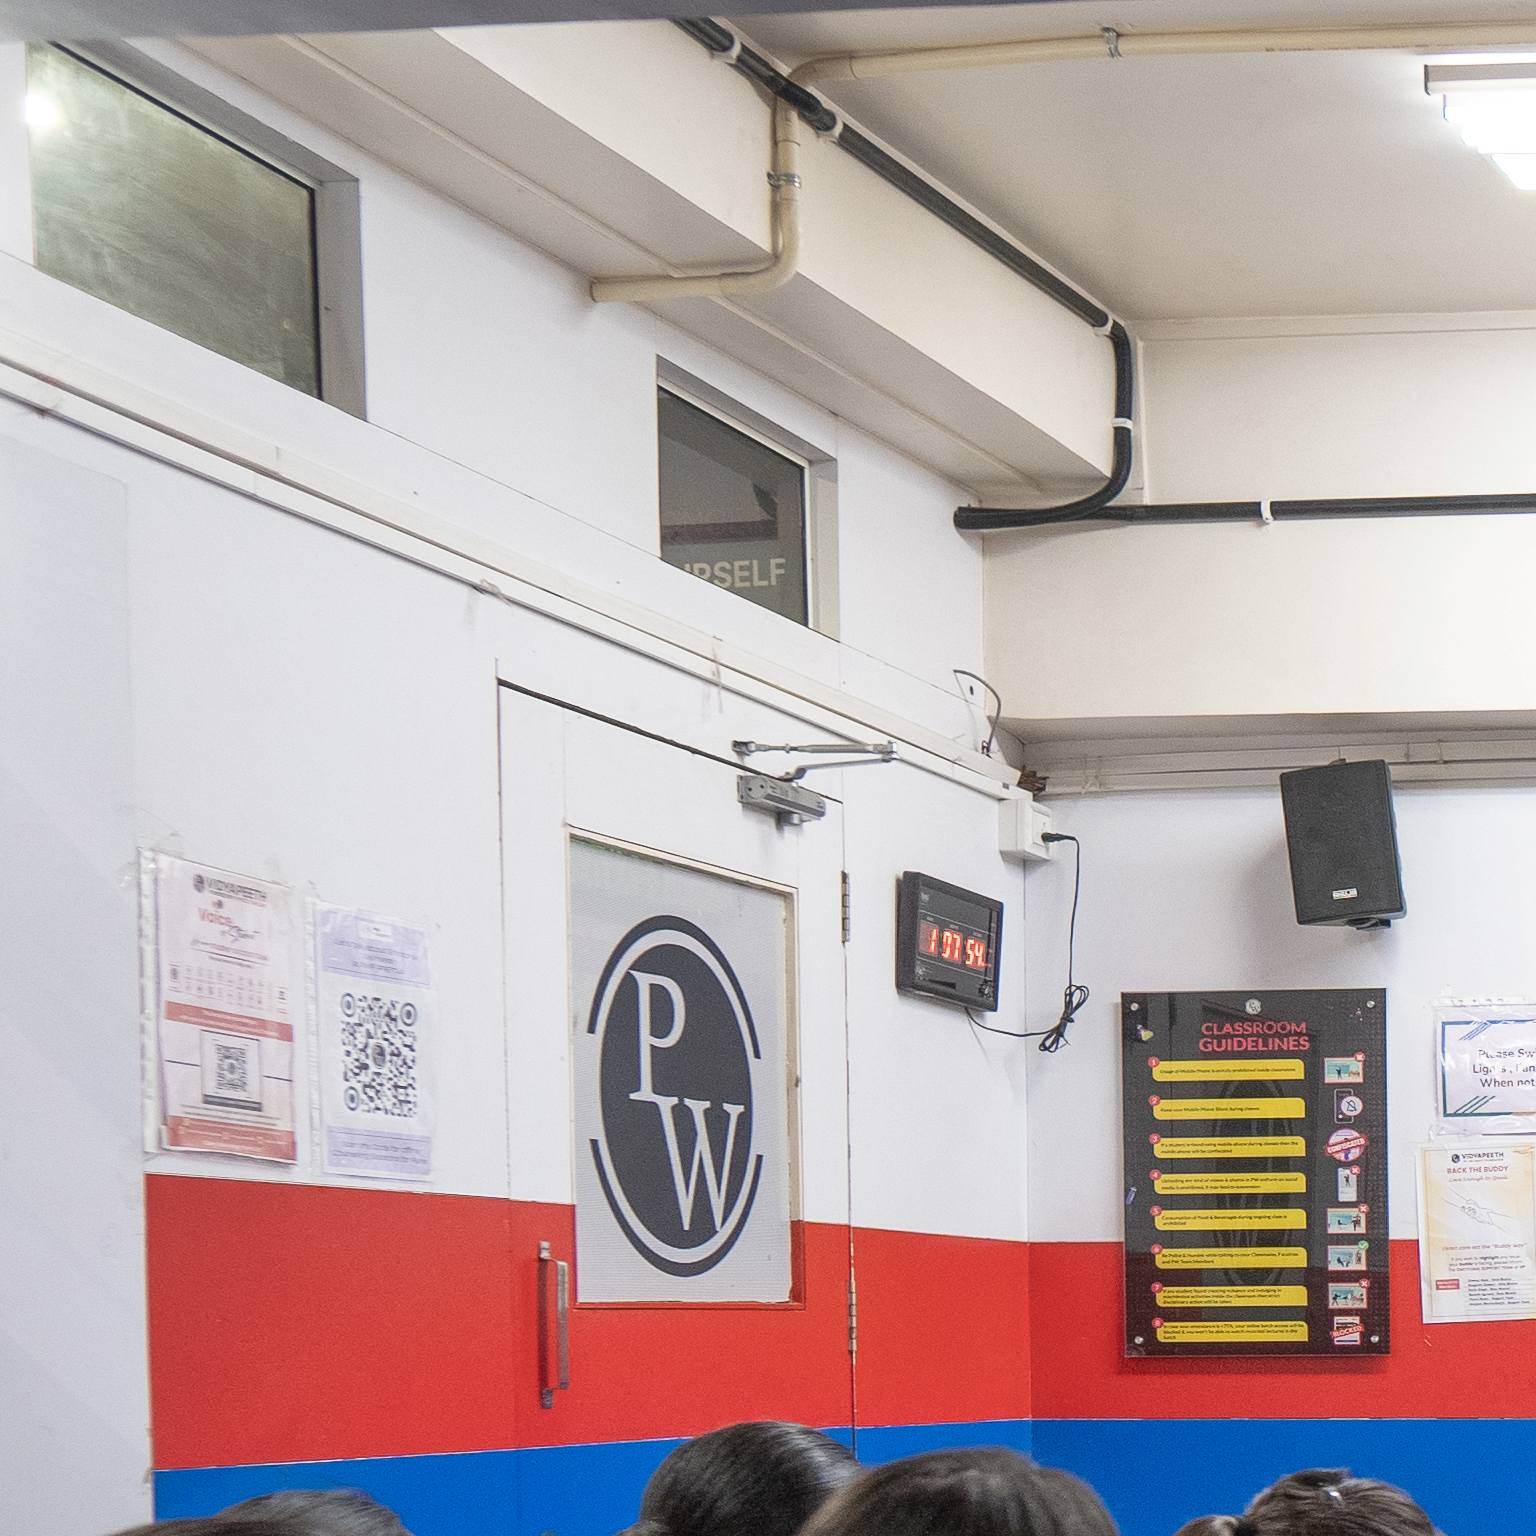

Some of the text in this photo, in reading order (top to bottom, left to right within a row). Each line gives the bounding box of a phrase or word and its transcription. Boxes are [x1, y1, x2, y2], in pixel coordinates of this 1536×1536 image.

[684, 558, 786, 588] RSELF
[1201, 1021, 1307, 1035] CLASSROOM
[1198, 1036, 1311, 1051] GUIDELINES
[1479, 1078, 1514, 1088] When
[1517, 1078, 1536, 1087] not
[629, 968, 745, 1232] PW
